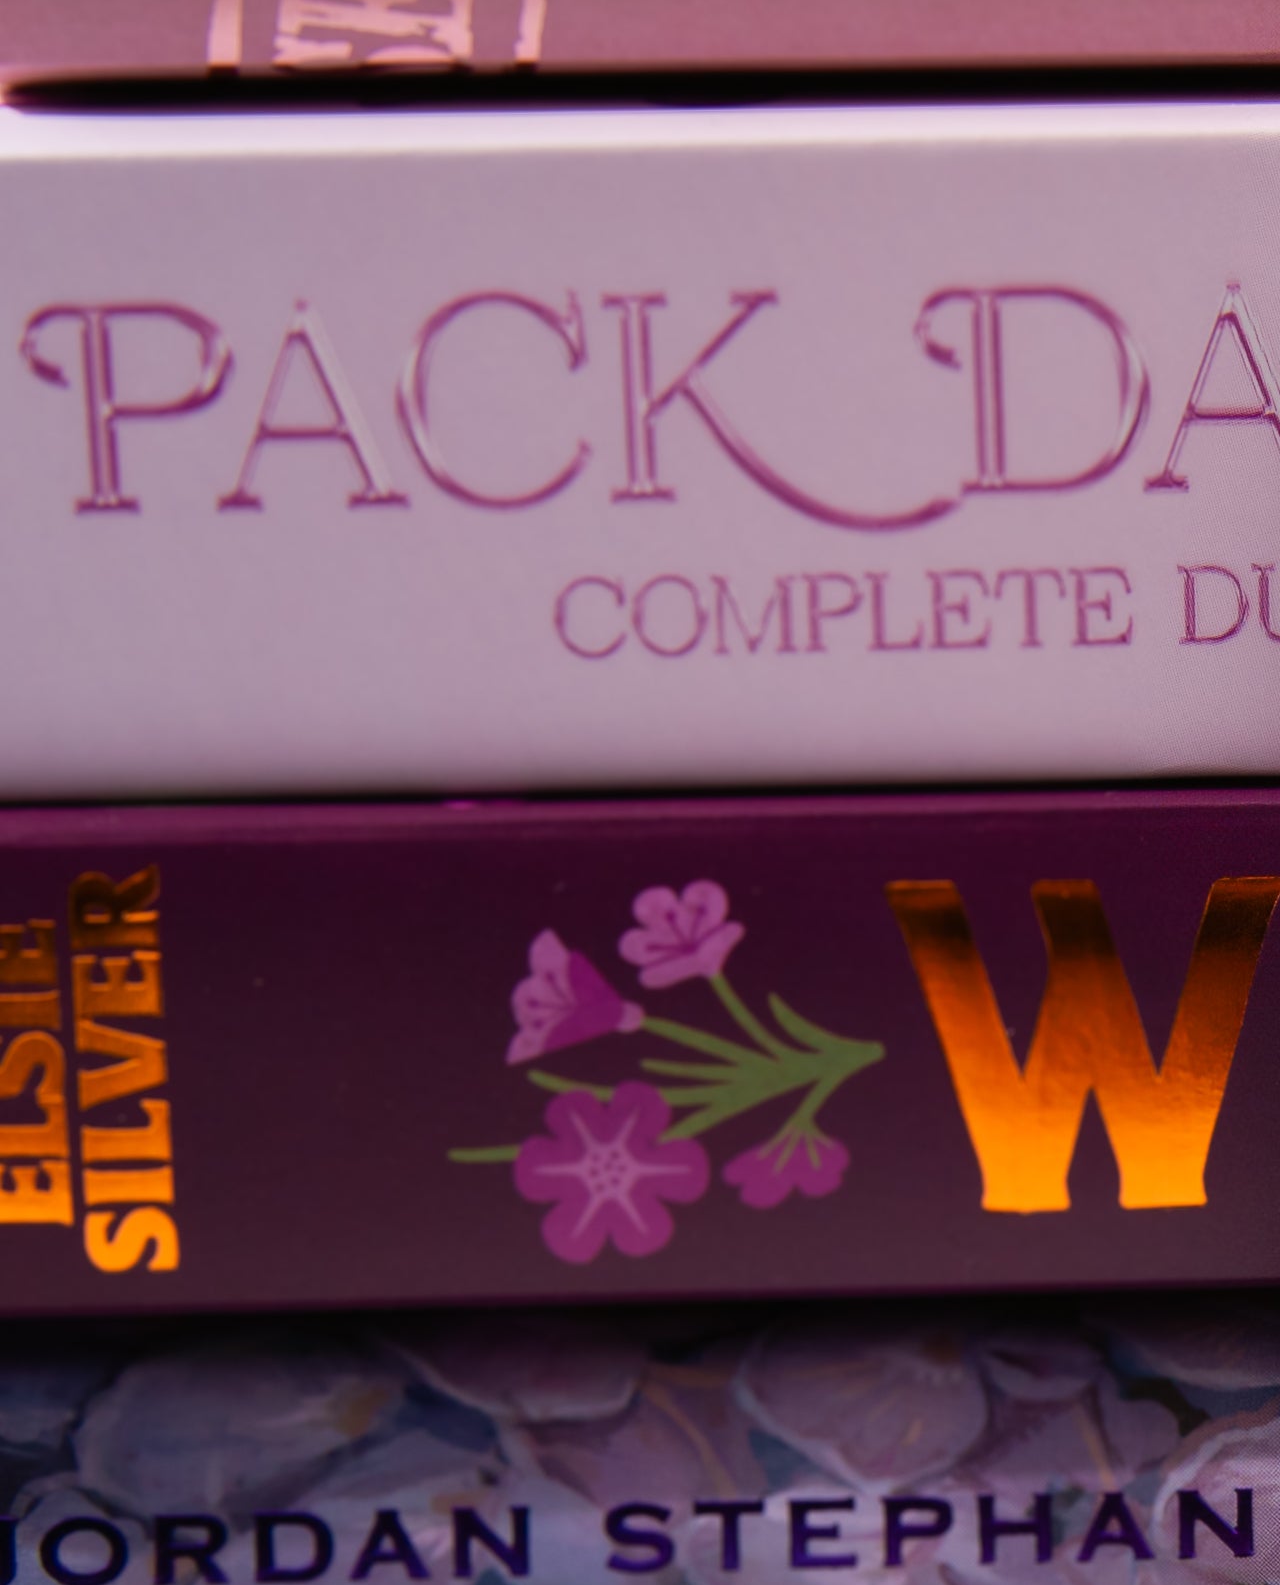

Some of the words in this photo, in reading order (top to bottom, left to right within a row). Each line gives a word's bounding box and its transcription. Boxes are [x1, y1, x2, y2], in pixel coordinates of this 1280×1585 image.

[20, 288, 962, 534] PACK
[553, 566, 1136, 661] COMPLETE
[68, 862, 180, 1272] SILVER
